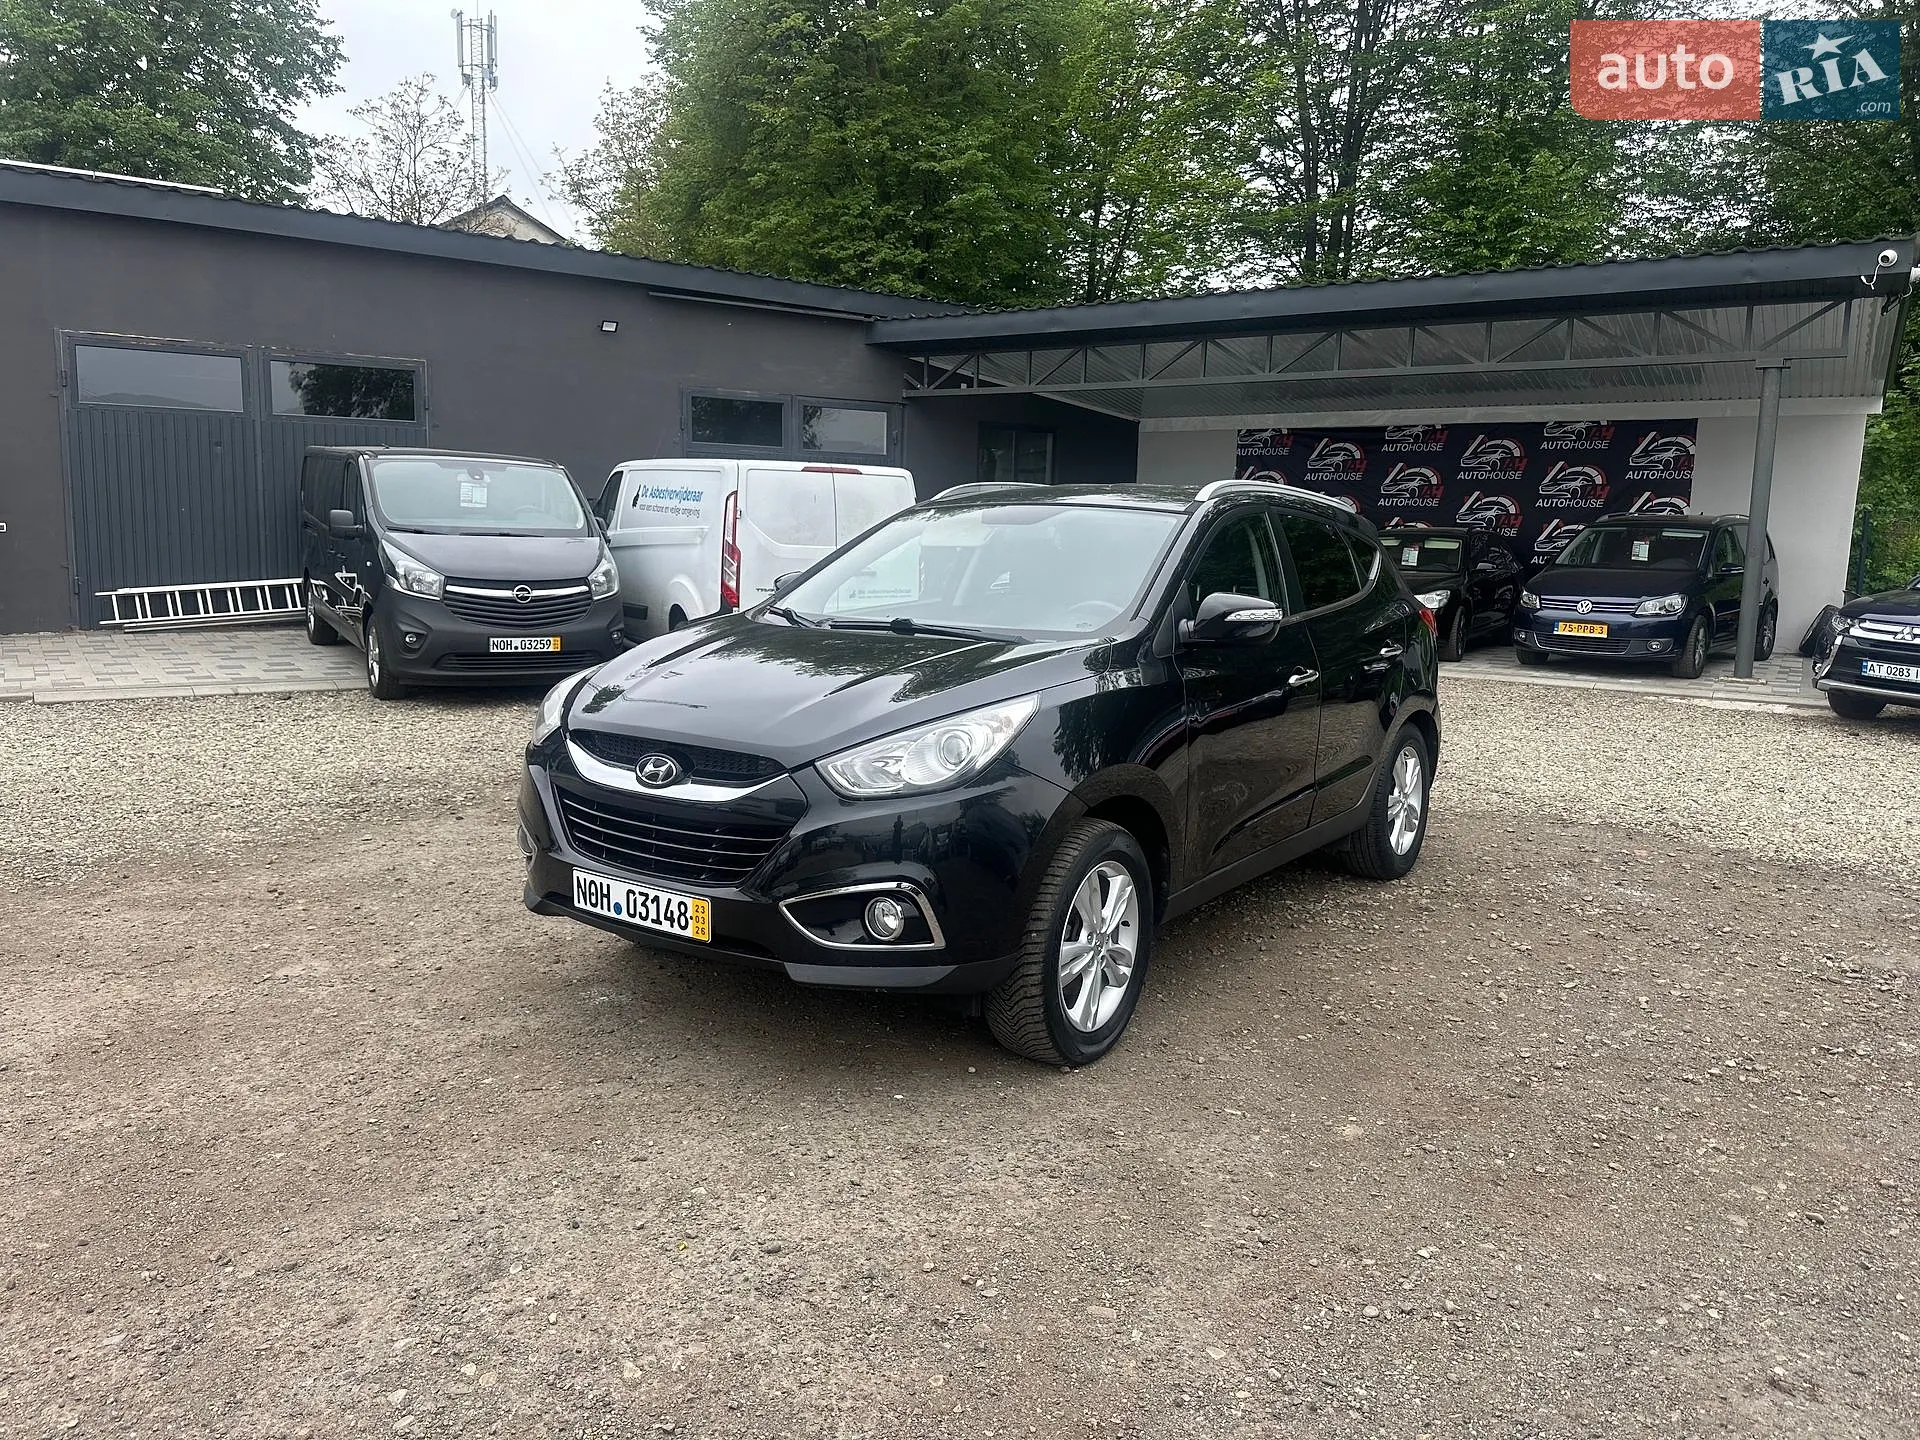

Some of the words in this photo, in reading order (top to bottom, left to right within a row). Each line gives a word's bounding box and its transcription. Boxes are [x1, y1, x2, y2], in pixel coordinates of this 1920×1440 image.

[1381, 442, 1444, 452] AUTOHOUSE
[1540, 440, 1610, 450] AUTOHOUSE
[1236, 447, 1290, 456] AUTOHOUSE
[1304, 472, 1363, 481] AUTOHOUSE
[1457, 471, 1523, 480] AUTOHOUSE
[641, 484, 649, 498] De
[1377, 498, 1441, 507] AUTOHOUSE
[1535, 499, 1605, 508] AUTOHOUSE
[1562, 624, 1604, 635] 75-PPB-3
[520, 639, 552, 650] 03259
[1868, 663, 1884, 674] AT
[1886, 665, 1911, 677] 0283
[626, 888, 689, 931] 03148
[695, 904, 706, 914] 23
[695, 915, 706, 925] 03
[695, 925, 706, 935] 26
